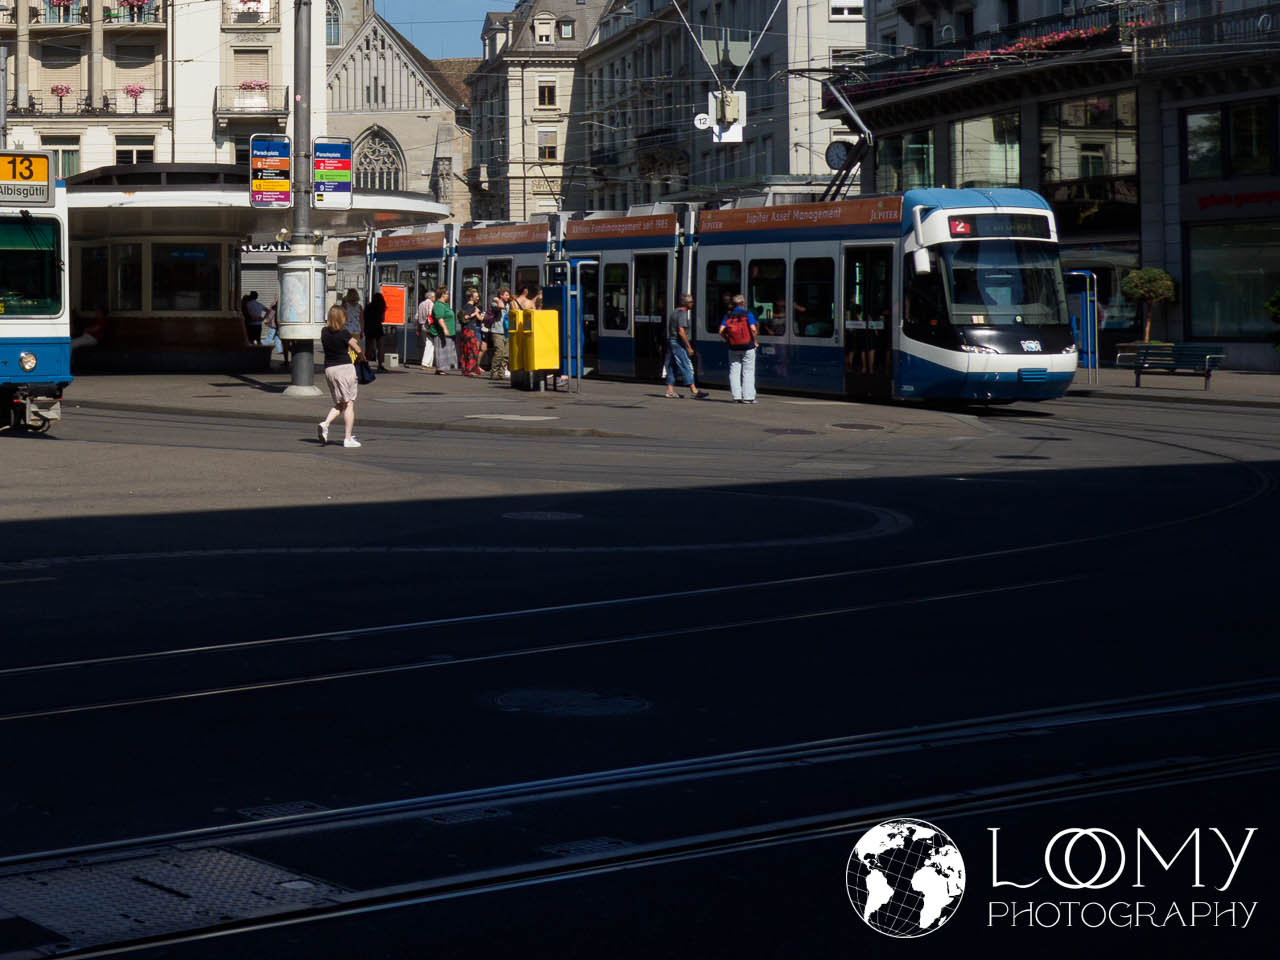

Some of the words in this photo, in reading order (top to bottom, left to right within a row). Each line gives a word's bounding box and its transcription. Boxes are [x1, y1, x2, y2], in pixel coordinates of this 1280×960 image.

[699, 117, 707, 125] 12
[7, 157, 34, 180] 13
[771, 211, 791, 222] Asset
[792, 207, 841, 222] Management
[870, 209, 899, 223] JUPITER
[956, 221, 965, 232] 2
